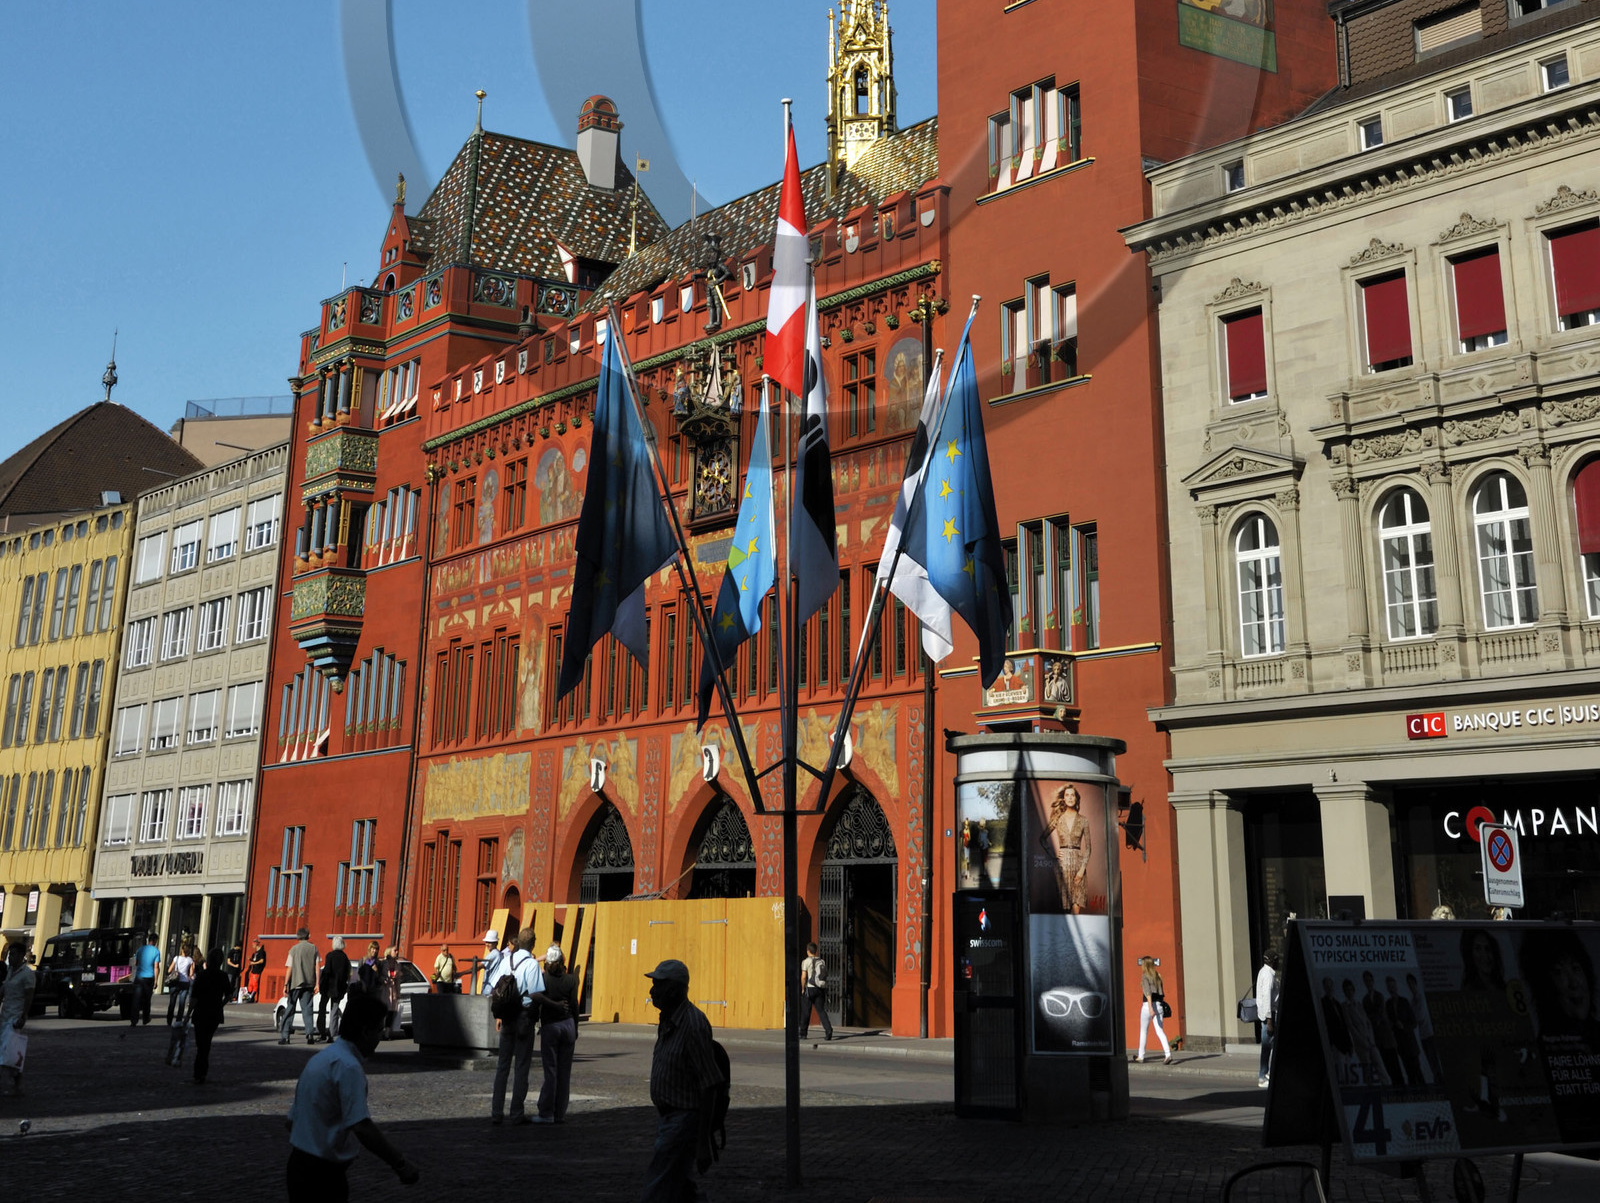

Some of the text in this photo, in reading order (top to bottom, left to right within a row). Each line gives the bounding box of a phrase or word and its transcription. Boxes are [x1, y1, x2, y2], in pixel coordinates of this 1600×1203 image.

[1410, 716, 1442, 734] CIC
[1453, 711, 1522, 731] BANQUE
[1525, 708, 1555, 725] CIC
[969, 936, 1004, 948] swisscom
[1310, 934, 1333, 947] TOO
[1335, 934, 1370, 947] SMALL
[1371, 934, 1386, 947] TO
[1388, 934, 1411, 947] FAIL
[1313, 950, 1357, 963] TYPISCH
[1360, 949, 1407, 962] SCHWEIZ
[1513, 990, 1528, 1014] 8
[1547, 1055, 1574, 1067] FAIRE
[1551, 1067, 1593, 1081] FÜR ALLE
[1554, 1083, 1581, 1096] STATT
[1582, 1080, 1600, 1095] FÜR
[1353, 1088, 1392, 1156] 4
[1415, 1116, 1451, 1140] EVP
